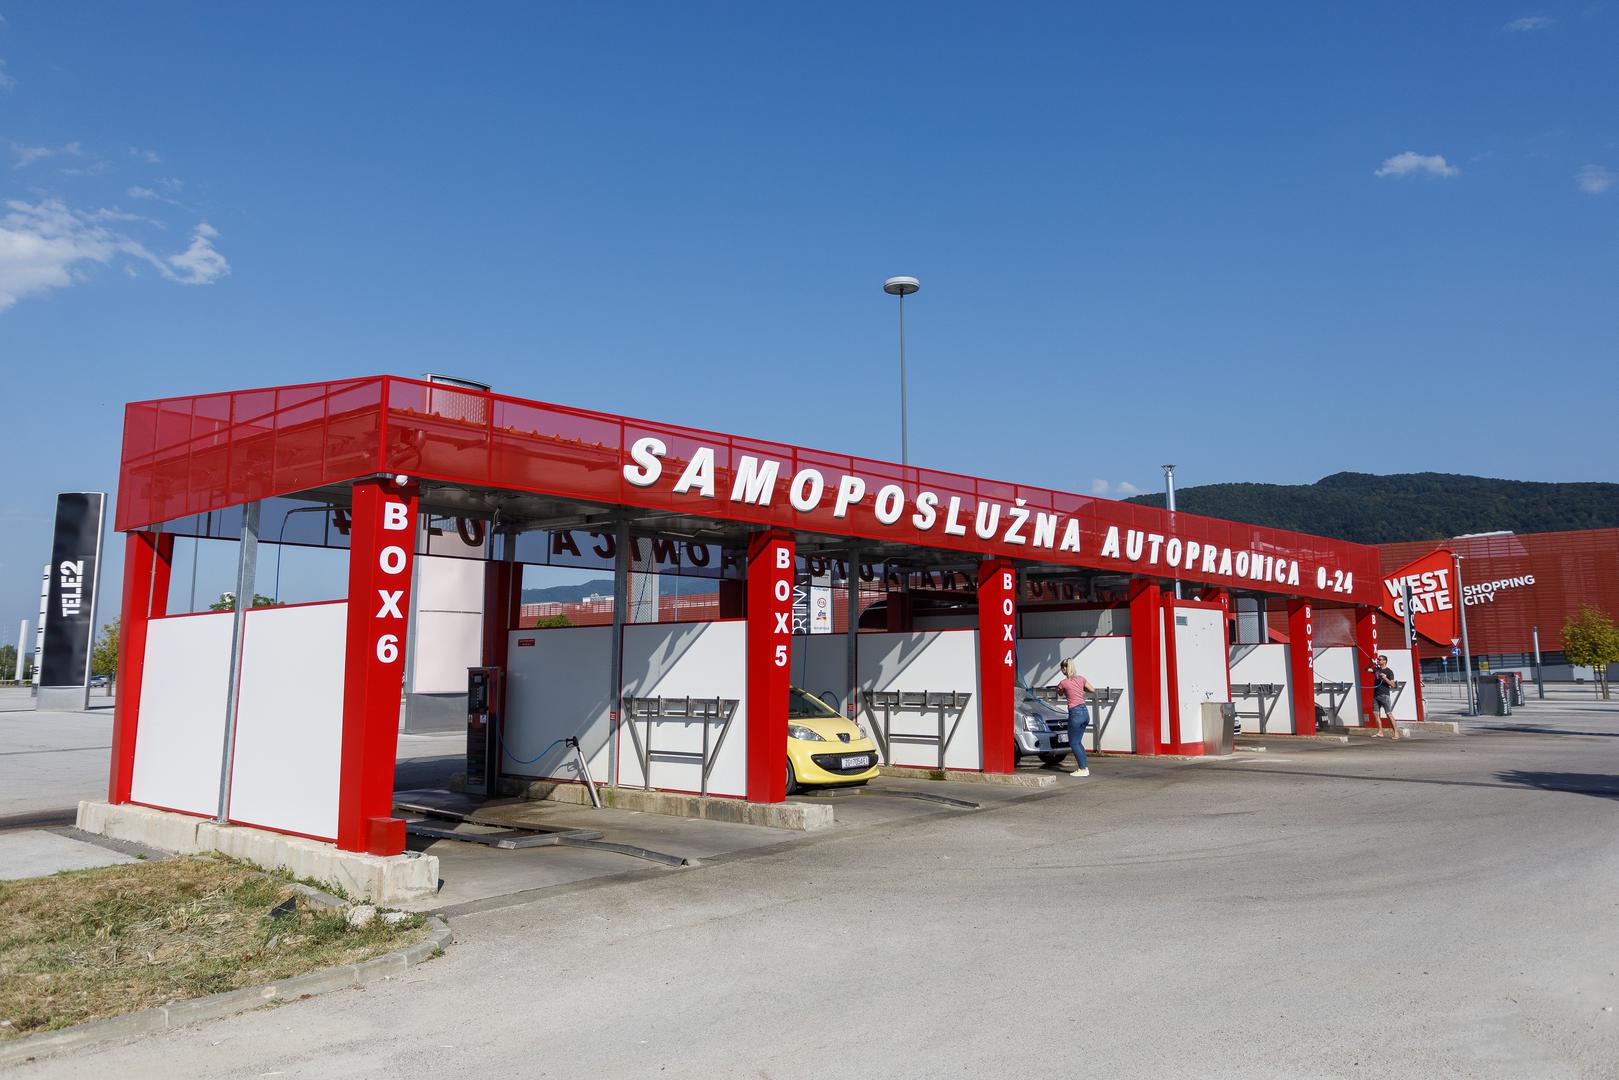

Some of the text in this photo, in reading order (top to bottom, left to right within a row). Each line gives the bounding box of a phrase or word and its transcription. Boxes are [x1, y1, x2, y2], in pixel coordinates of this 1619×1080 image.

[623, 437, 1353, 594] SAMOPOSLUŽNA AUTOPRAONICA 0-24
[60, 560, 84, 617] TELE2
[376, 501, 408, 664] BOX 6
[1384, 569, 1449, 598] WEST
[1393, 591, 1453, 617] GATE
[1463, 575, 1536, 596] SHOPPING
[1464, 592, 1495, 606] CITY
[774, 547, 790, 667] BOX 5
[1003, 573, 1013, 667] BOX 4
[1308, 656, 1313, 668] 2
